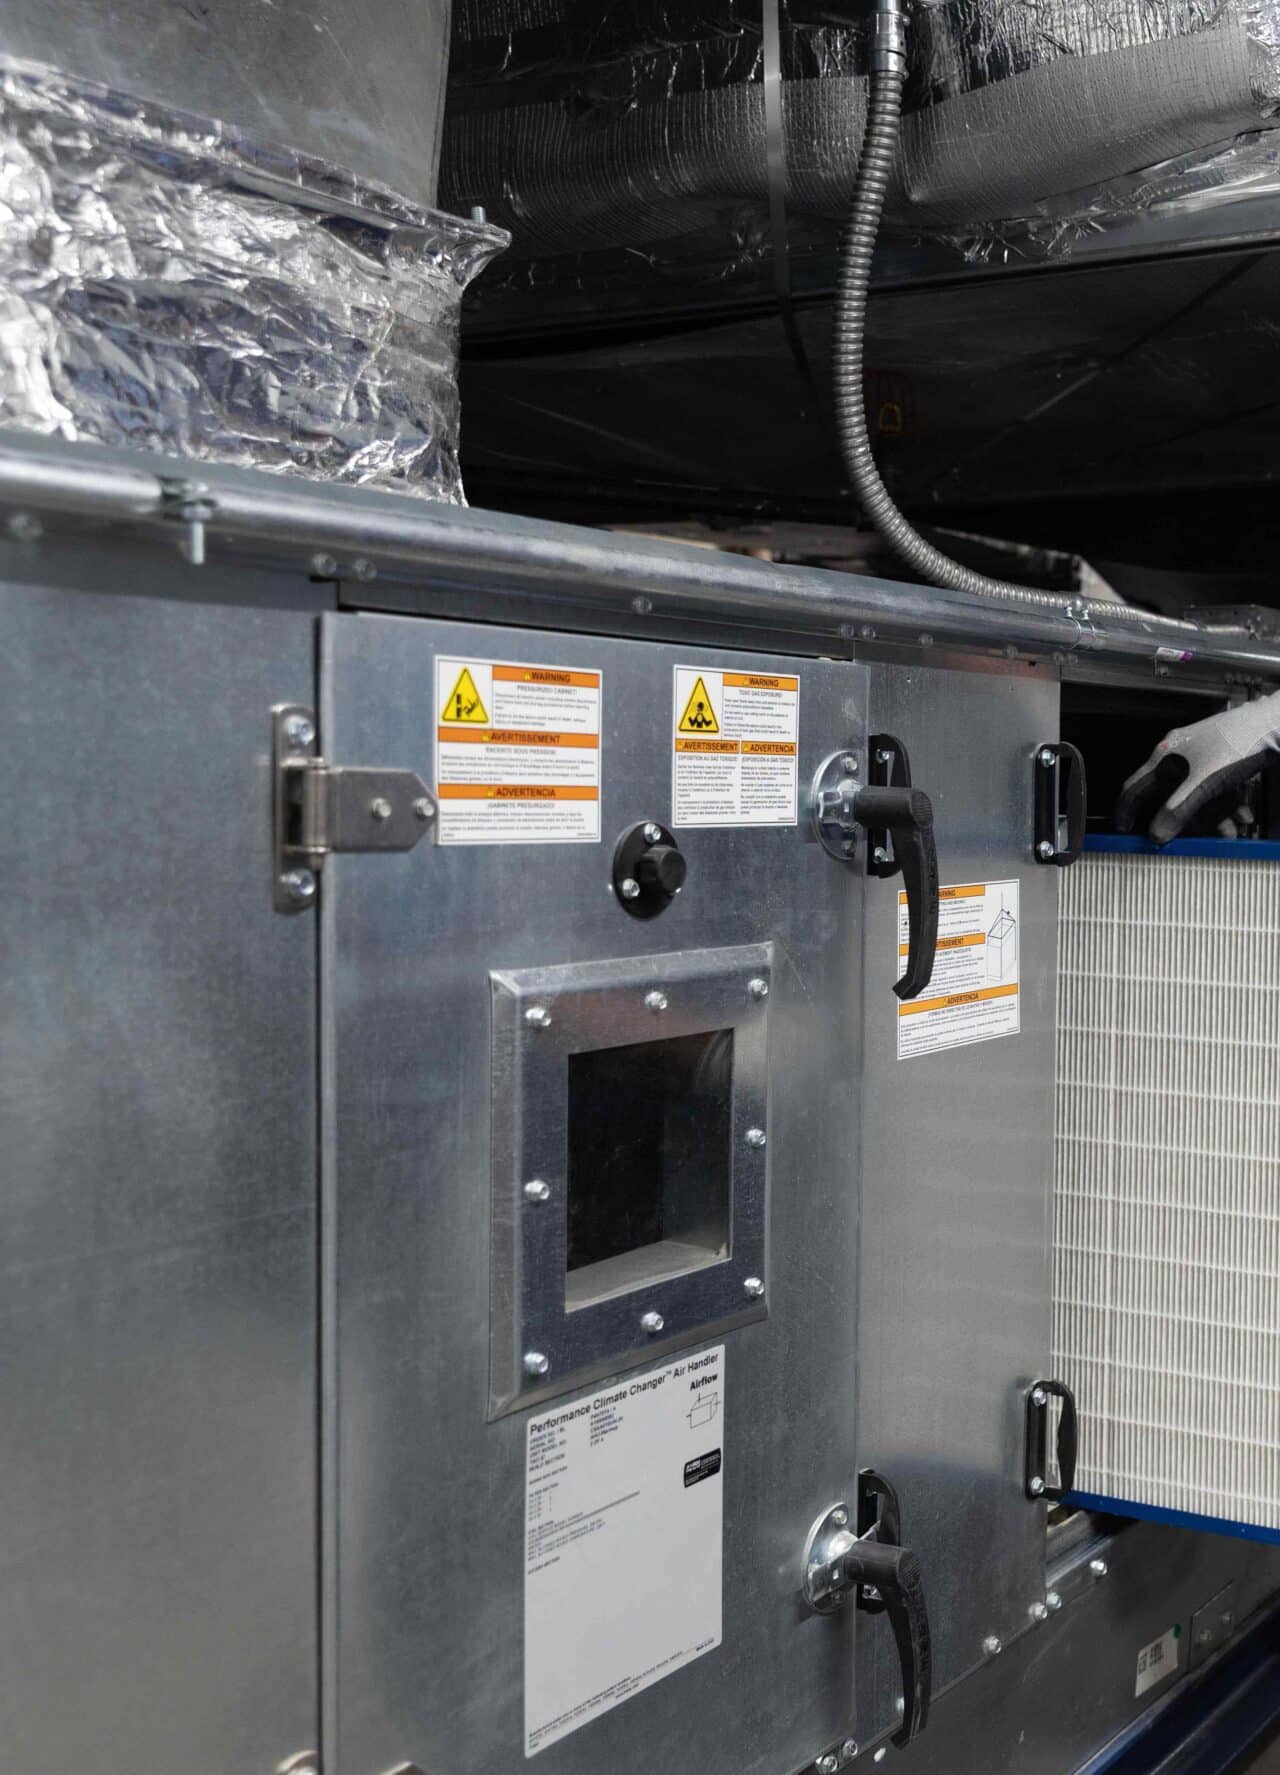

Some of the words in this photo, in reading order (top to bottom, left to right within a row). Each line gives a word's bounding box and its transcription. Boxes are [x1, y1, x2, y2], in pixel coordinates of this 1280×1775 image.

[531, 671, 571, 683] WARNING
[749, 678, 779, 688] WARNING
[490, 733, 560, 744] AVERTISSEMENT
[684, 741, 738, 752] AVERTISSEMENT
[750, 743, 794, 753] ADVERTENCIA
[496, 787, 556, 798] ADVERTENCIA
[947, 992, 978, 1004] ADVERTENCIA
[690, 1373, 719, 1391] Airflow
[530, 1404, 591, 1435] Performance
[593, 1390, 627, 1410] Climate
[673, 1364, 686, 1379] Air
[688, 1353, 719, 1373] Handler
